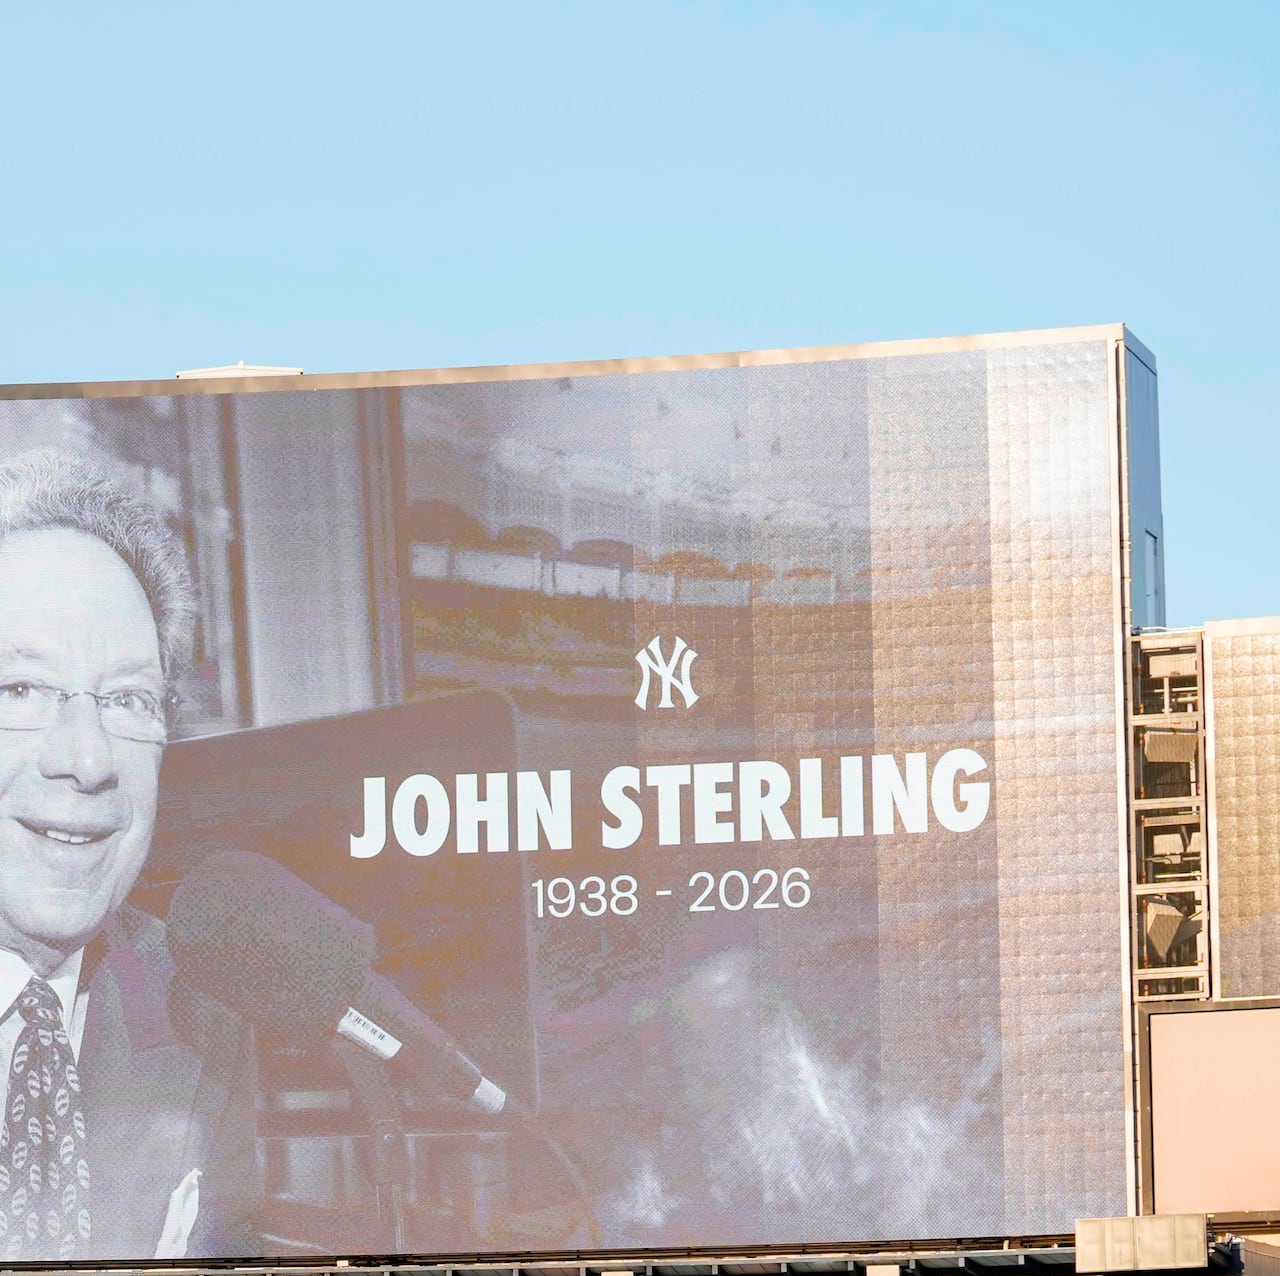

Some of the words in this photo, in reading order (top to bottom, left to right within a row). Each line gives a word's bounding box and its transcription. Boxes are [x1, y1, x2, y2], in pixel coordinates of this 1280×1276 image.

[350, 769, 572, 860] JOHN
[601, 748, 991, 850] STERLING
[532, 875, 639, 919] 1938
[689, 867, 812, 913] 2026
